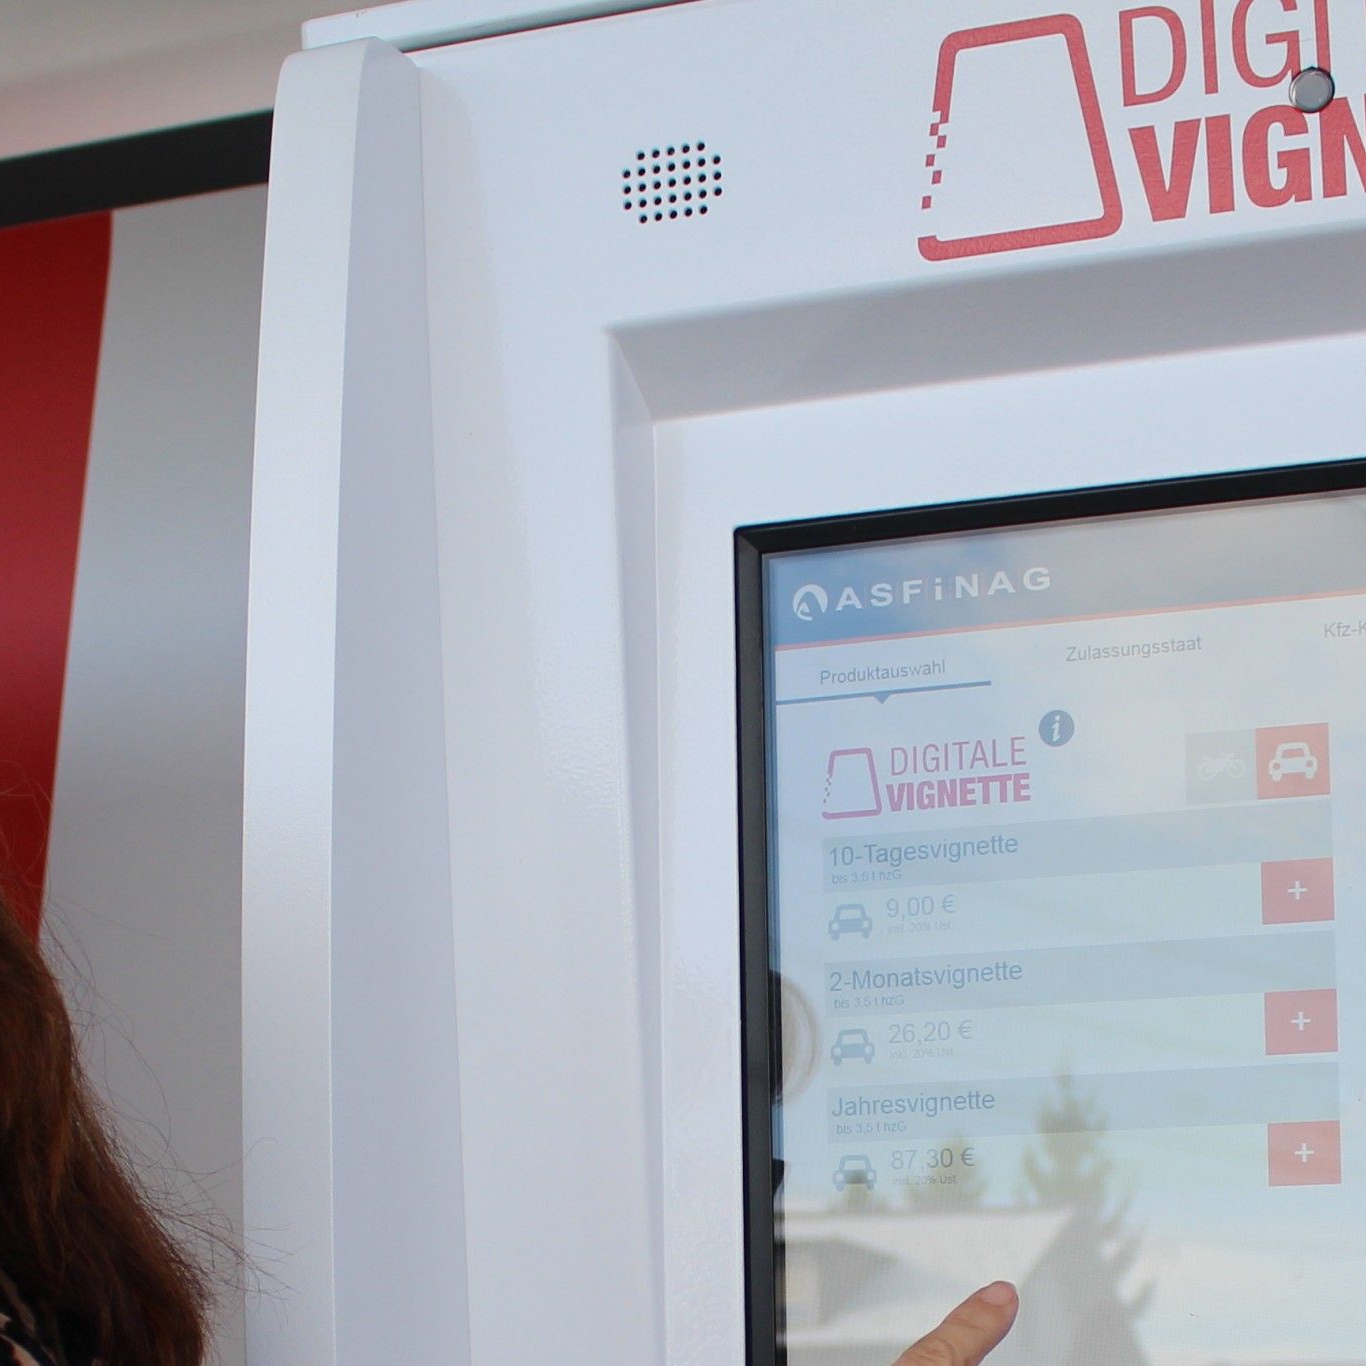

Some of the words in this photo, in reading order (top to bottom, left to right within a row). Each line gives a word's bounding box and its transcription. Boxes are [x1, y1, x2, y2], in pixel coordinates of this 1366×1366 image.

[820, 660, 946, 685] Produktauswahl
[1066, 636, 1202, 663] Zulassungsstaat
[891, 736, 1026, 777] DIGITALE
[885, 772, 1032, 812] VIGNETTE
[829, 835, 1019, 867] 10-Tagesvignette
[886, 896, 934, 921] 9,00
[941, 894, 956, 914] €
[829, 960, 1023, 992] 2-Monatsvignette
[889, 1021, 950, 1045] 26,20
[958, 1019, 972, 1040] €
[832, 1090, 995, 1118] Jahresvignette
[891, 1148, 953, 1172] 87,30
[960, 1147, 975, 1167] €
